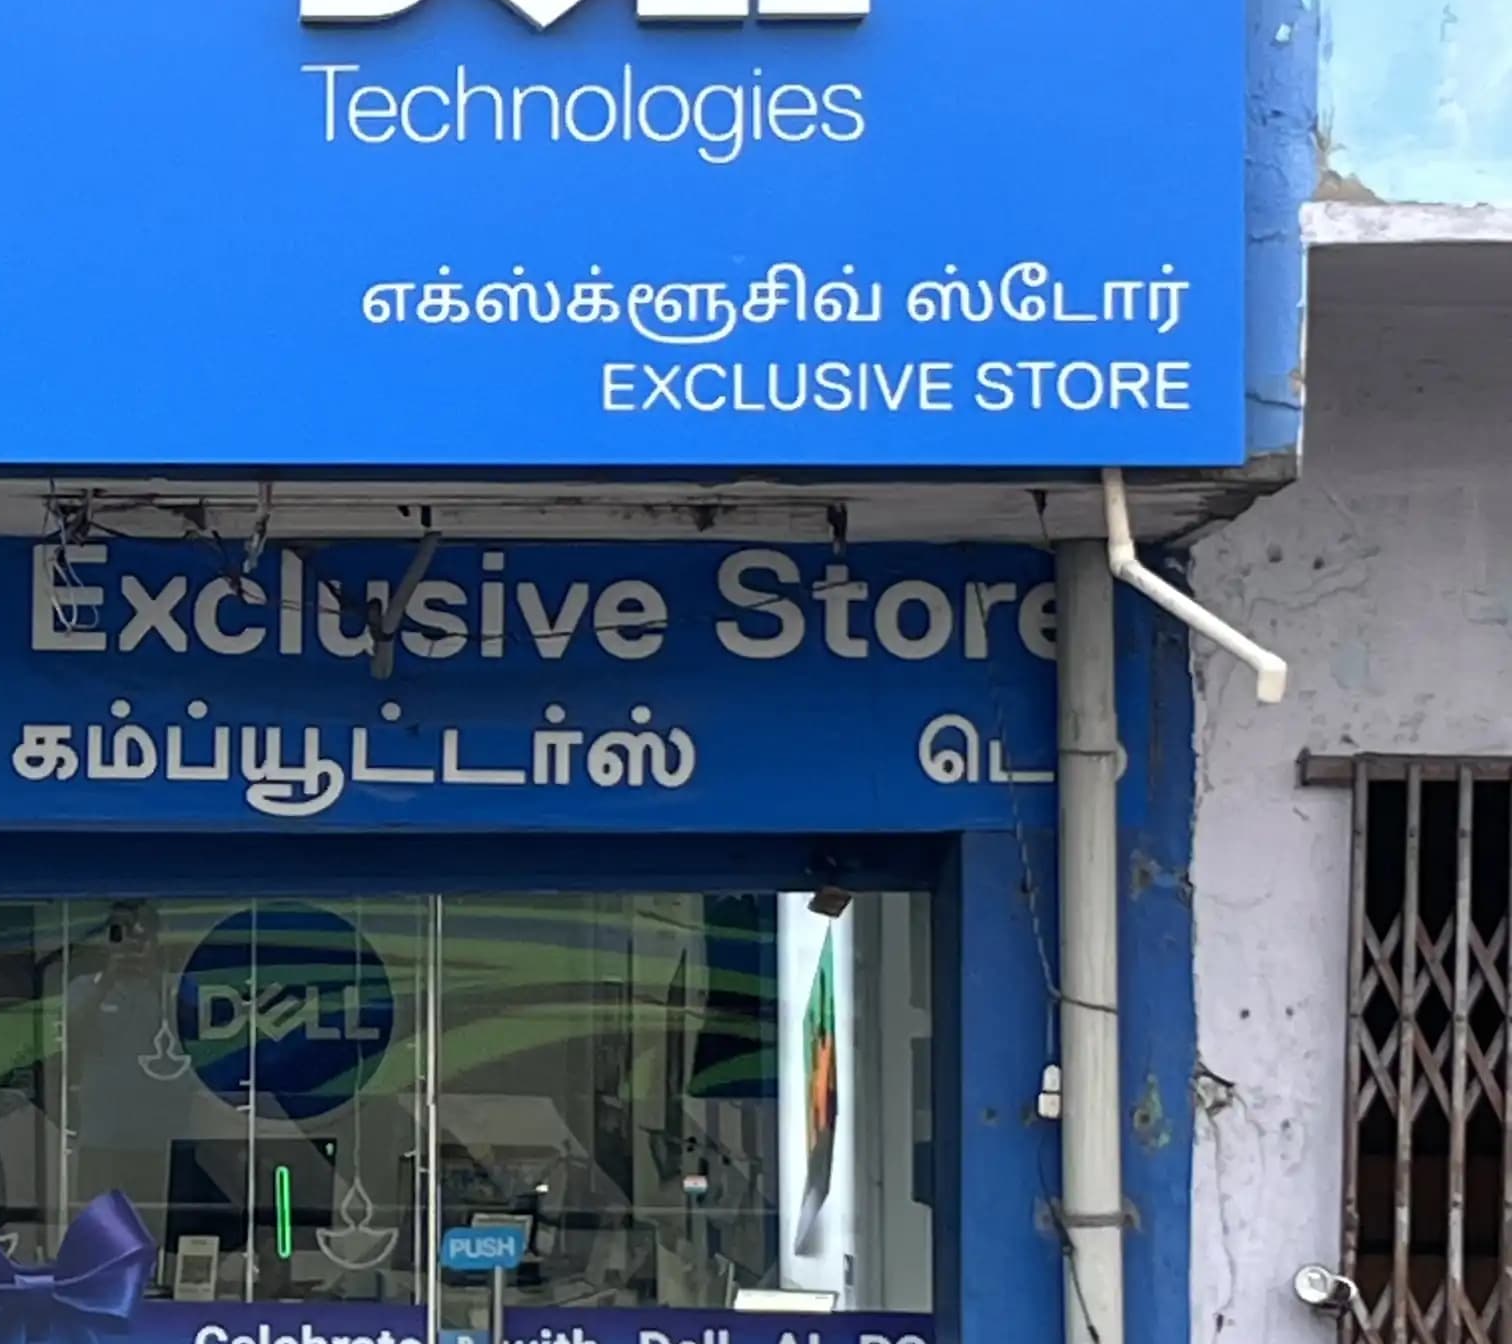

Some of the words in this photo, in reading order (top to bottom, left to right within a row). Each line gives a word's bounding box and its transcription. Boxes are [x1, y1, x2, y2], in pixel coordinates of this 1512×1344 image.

[301, 63, 865, 164] Technologies
[362, 262, 882, 344] எக்ஸ்க்ளூசிவ்
[907, 261, 1190, 333] ஸ்டோர்
[603, 362, 953, 412] EXCLUSIVE
[975, 361, 1191, 411] STORE
[32, 542, 668, 659] Exclusive
[918, 713, 1128, 783] டெ
[197, 981, 381, 1042] DELL
[448, 1235, 516, 1259] PUSH
